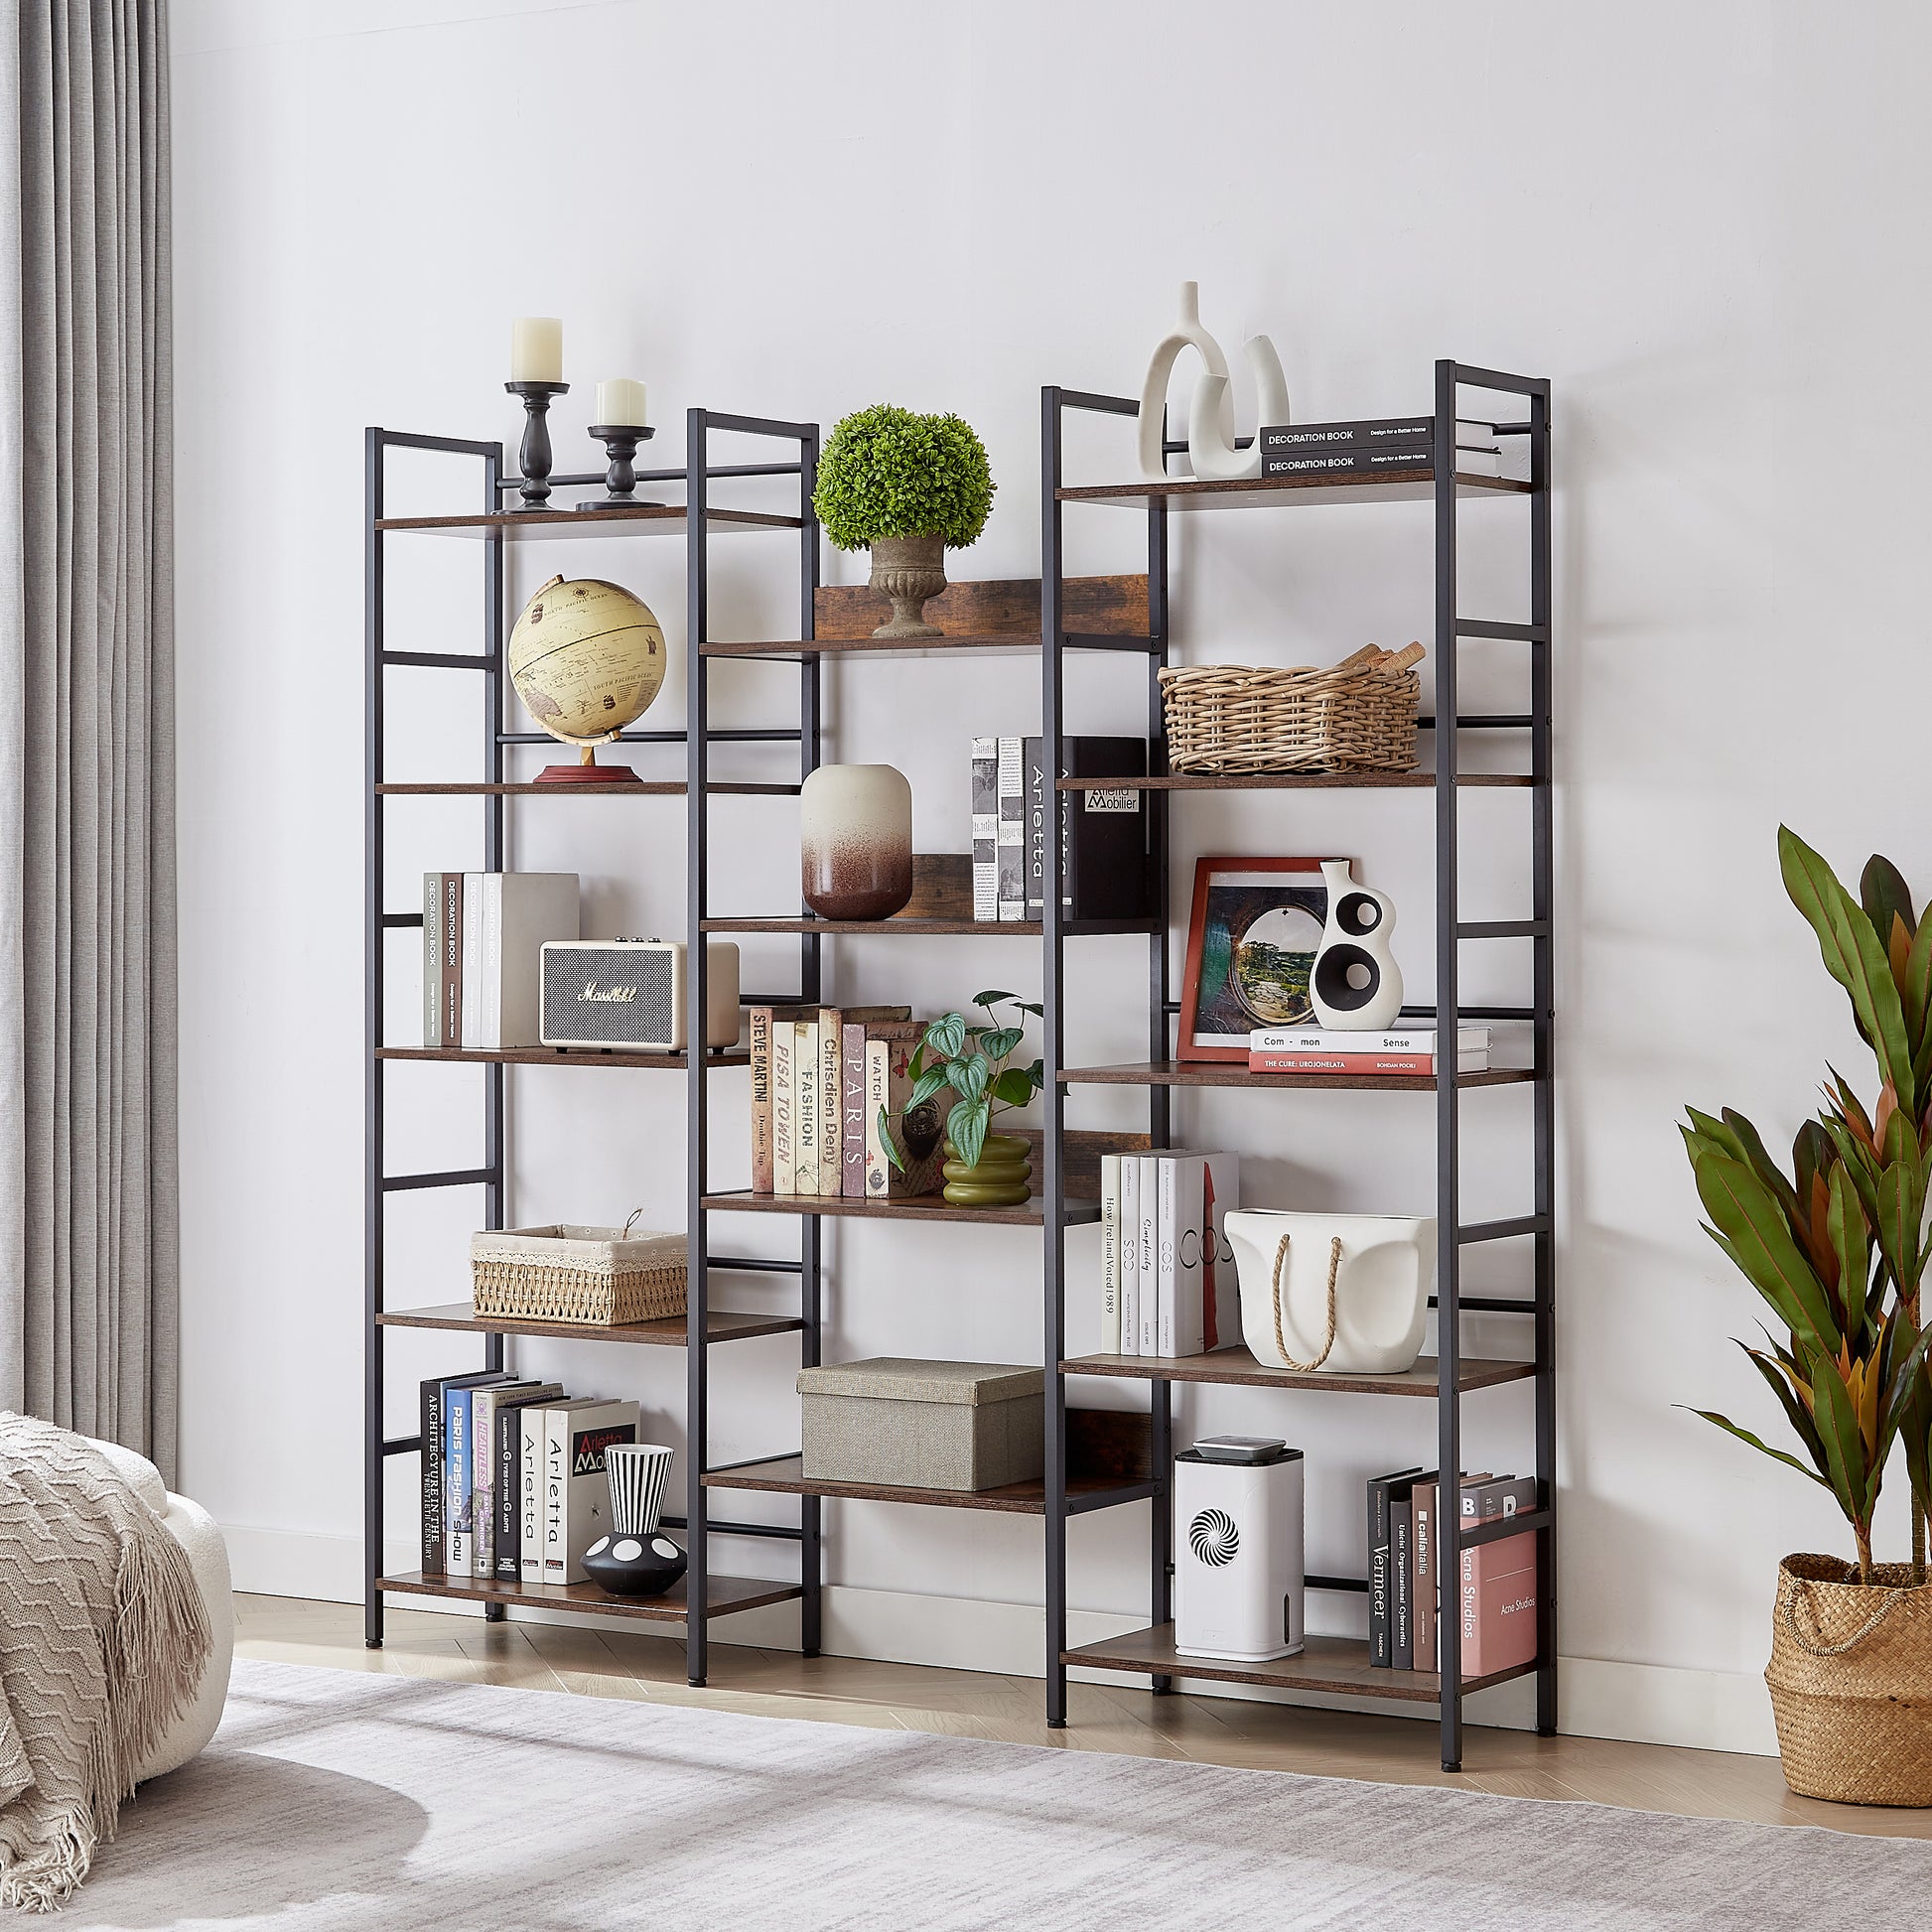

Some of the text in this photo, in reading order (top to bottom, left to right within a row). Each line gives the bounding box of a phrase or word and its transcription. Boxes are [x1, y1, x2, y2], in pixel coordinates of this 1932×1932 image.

[1268, 430, 1354, 445] DECORATION BOOK
[1269, 457, 1354, 472] DECORATION BOOK
[594, 680, 614, 691] SOUTH
[615, 674, 636, 684] PACIFIC
[1033, 764, 1044, 878] Arletta
[1087, 796, 1137, 810] Mobilier
[754, 1015, 768, 1103] STEVE MARTINI
[1264, 1036, 1285, 1046] Com
[1382, 1038, 1410, 1047] Sense
[776, 1044, 791, 1165] PISA TOWEN
[802, 1071, 814, 1147] FASHION
[846, 1058, 863, 1164] PARIS
[823, 1123, 838, 1166] Deny
[1124, 1239, 1135, 1271] COS
[1162, 1241, 1173, 1273] COS
[1179, 1226, 1234, 1269] COS
[479, 1423, 487, 1488] HEARTLESS
[580, 1434, 622, 1453] Arletta
[429, 1394, 440, 1543] ARCHITECYURE IN THE
[524, 1434, 535, 1539] Arletta
[548, 1438, 562, 1543] Arletta
[1462, 1497, 1475, 1515] B
[453, 1520, 462, 1562] SHOW
[1373, 1545, 1389, 1620] Vermeer
[1463, 1548, 1477, 1638] Acne Studios
[1500, 1596, 1536, 1615] Acne Studios
